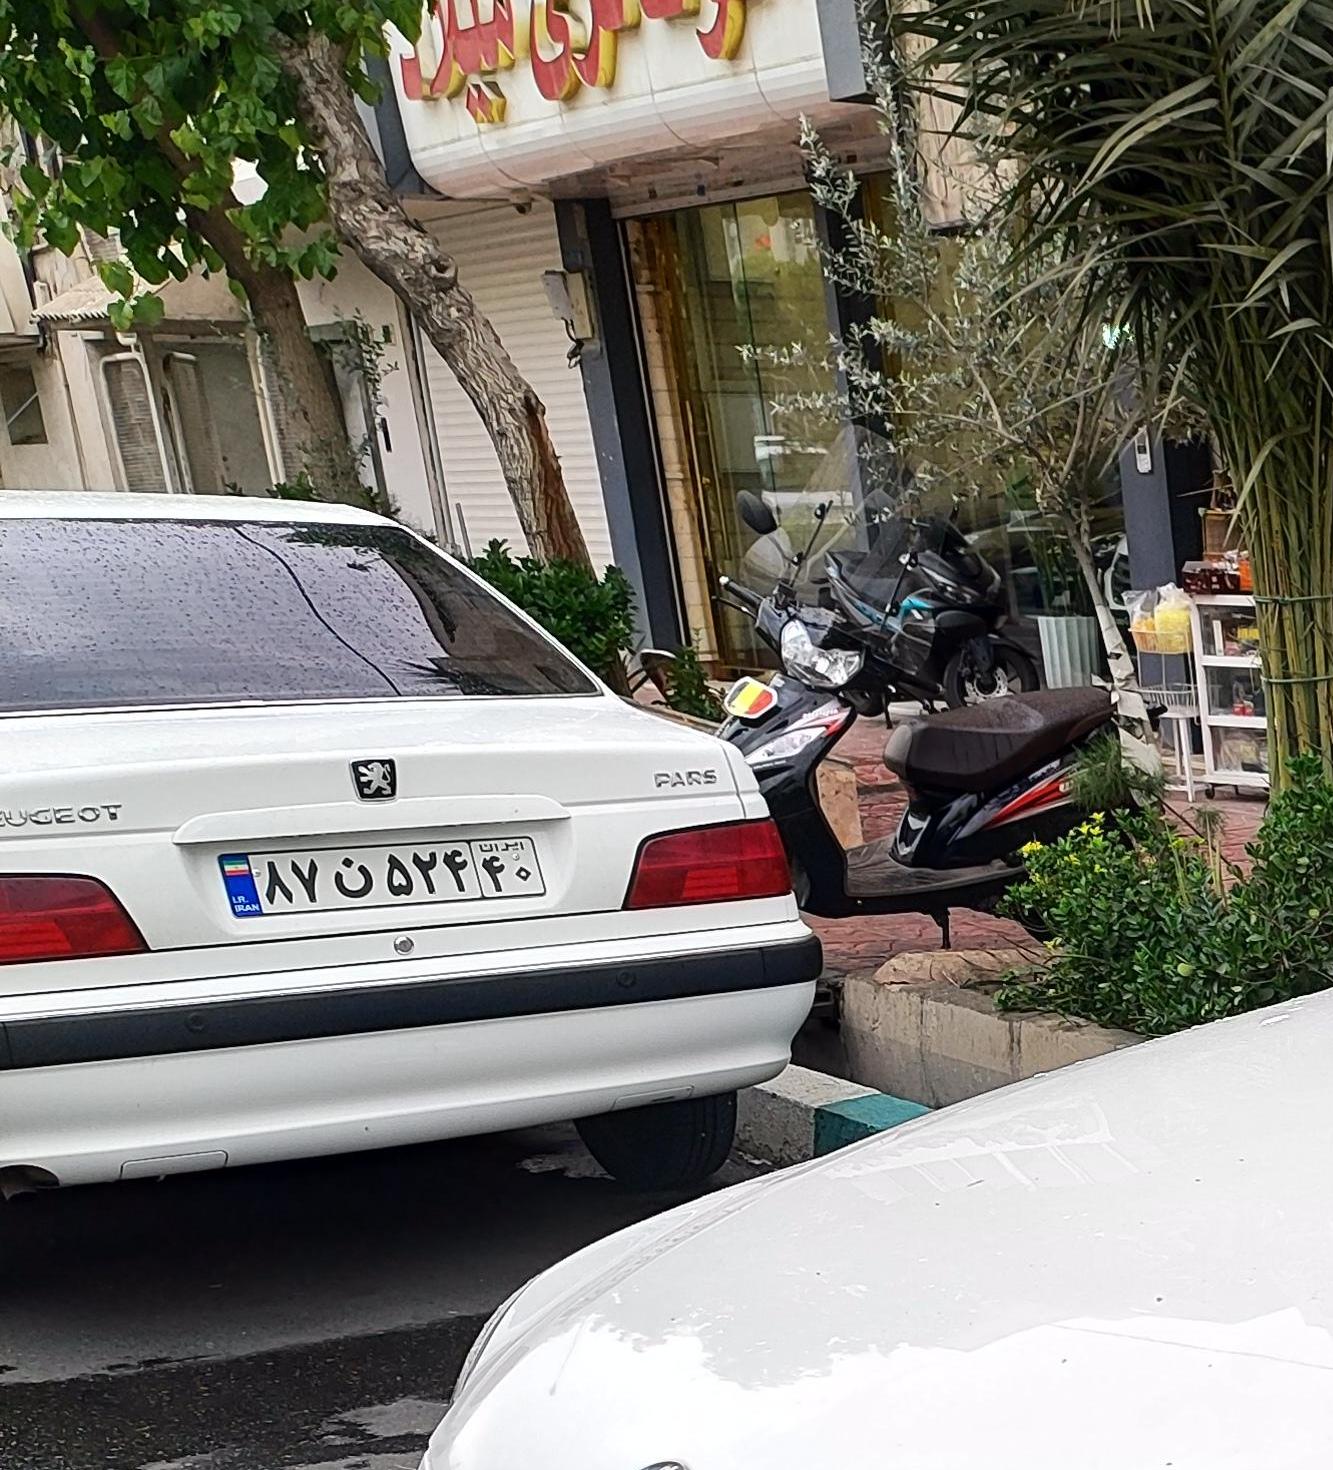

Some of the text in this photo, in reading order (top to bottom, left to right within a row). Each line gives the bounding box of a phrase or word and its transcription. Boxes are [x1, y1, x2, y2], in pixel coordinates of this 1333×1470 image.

[653, 769, 717, 788] PARS
[265, 849, 468, 905] ۸۷ ن ۵۲۴
[481, 855, 532, 893] ۴۰
[234, 903, 260, 913] IRAN
